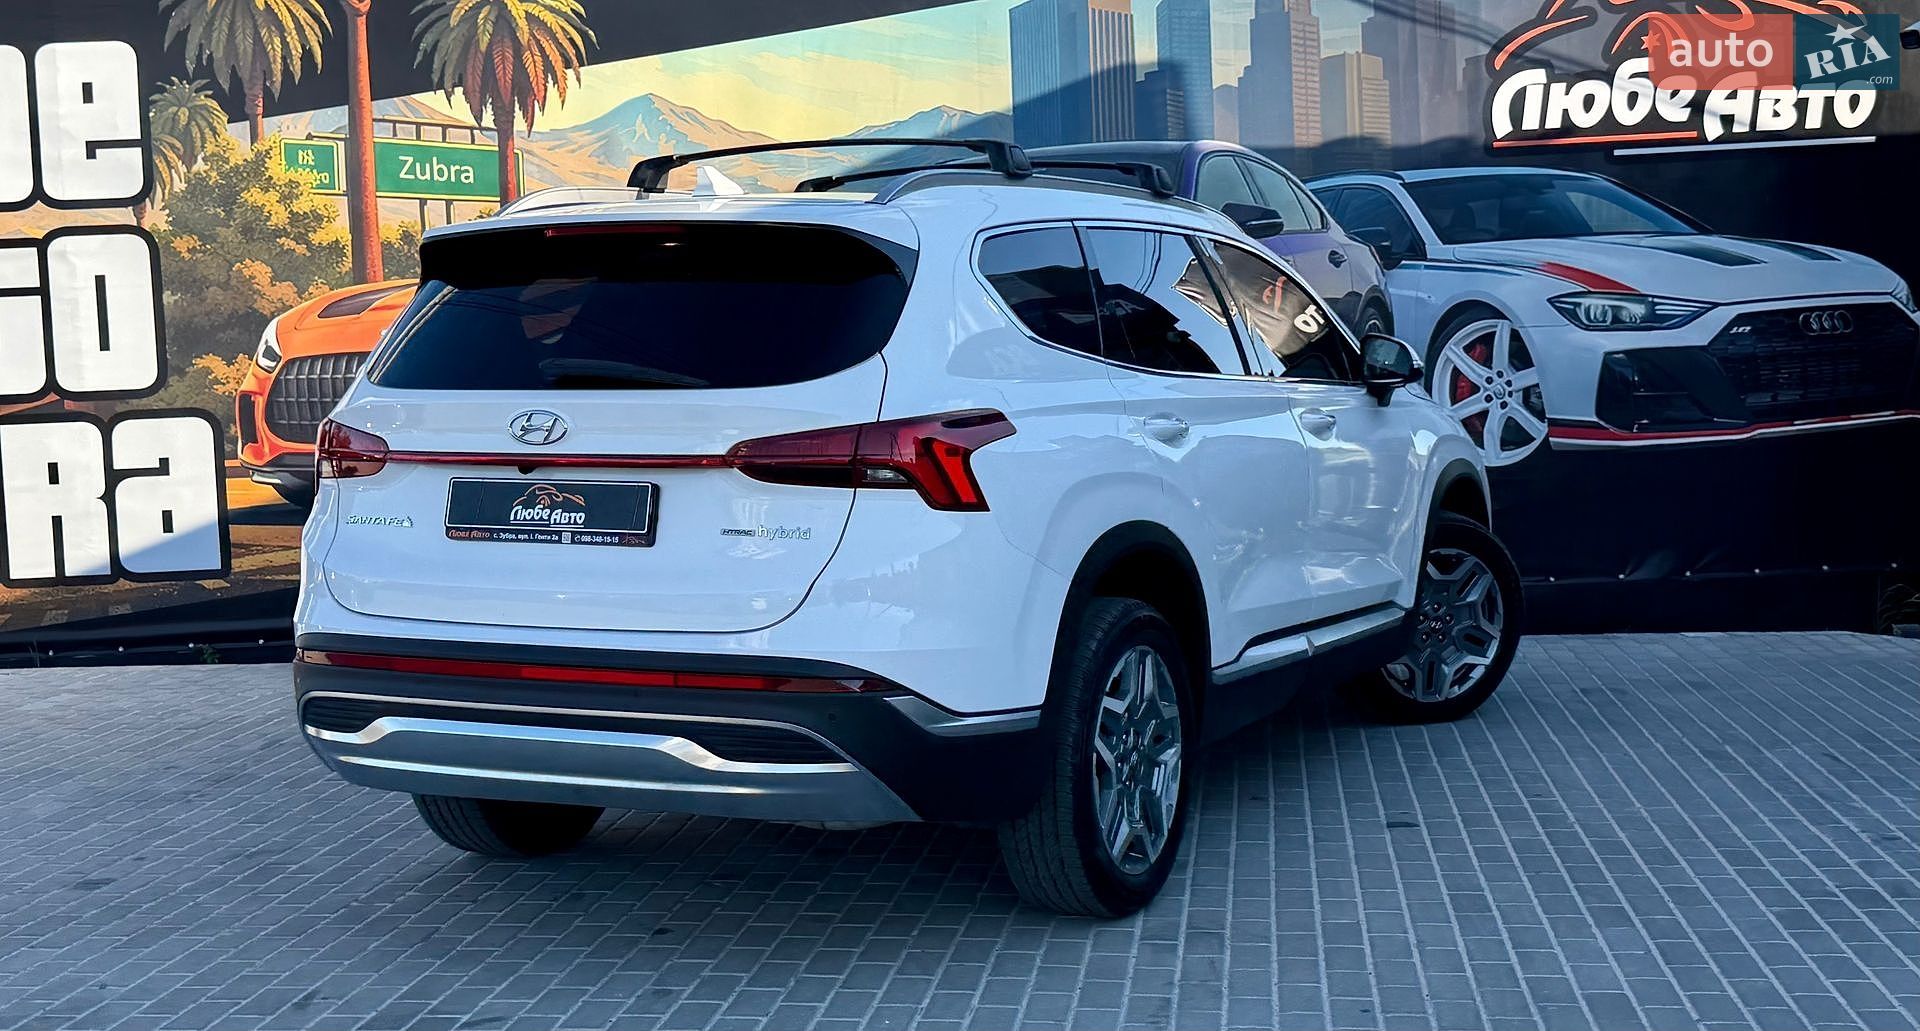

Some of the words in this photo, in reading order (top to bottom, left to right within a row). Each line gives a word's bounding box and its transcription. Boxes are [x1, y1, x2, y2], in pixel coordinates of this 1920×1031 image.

[1491, 57, 1698, 139] Любе
[399, 156, 474, 184] Zubra
[510, 505, 550, 520] Любе
[757, 525, 811, 540] hybrid
